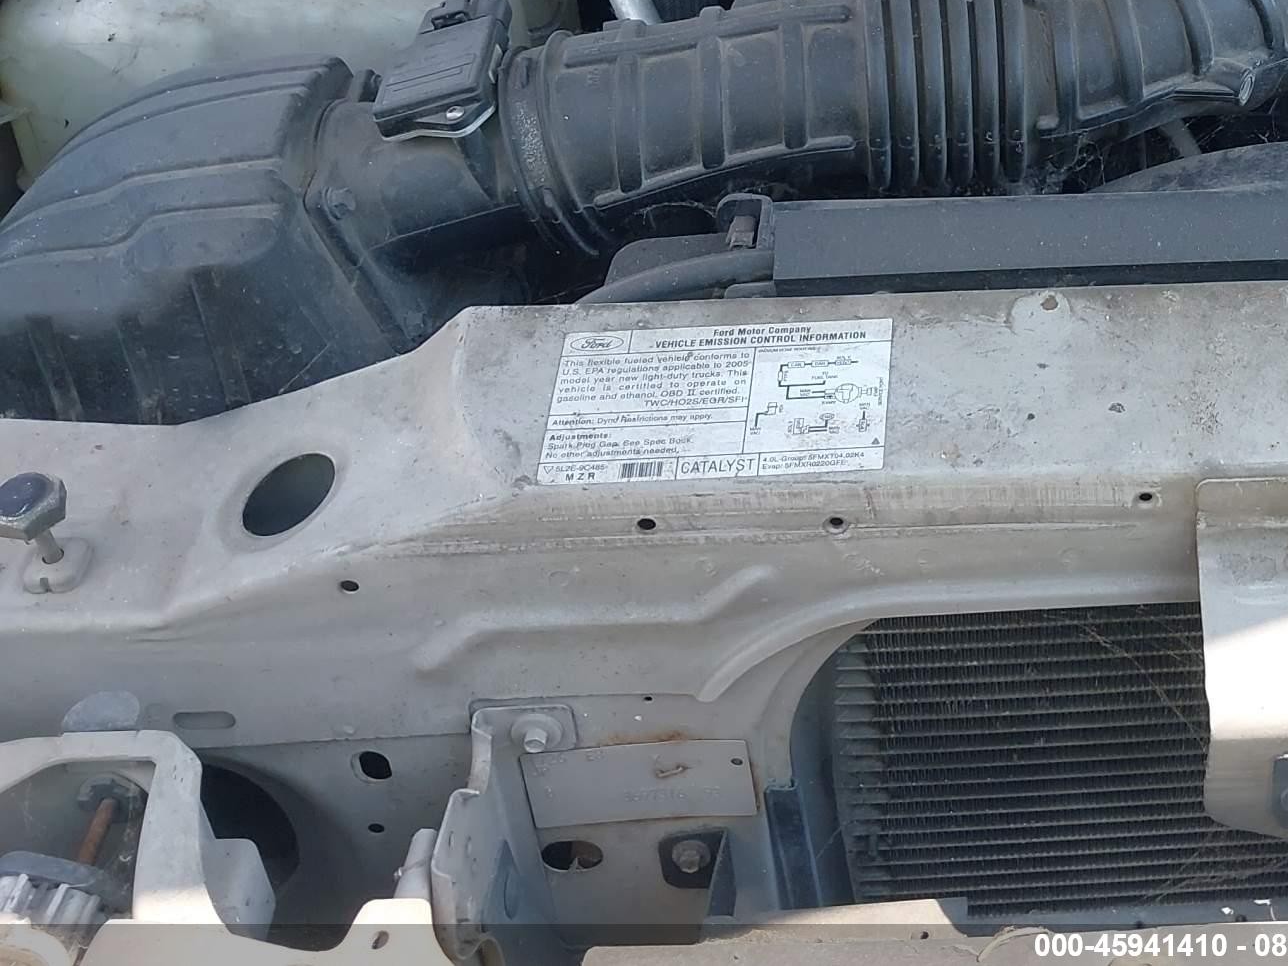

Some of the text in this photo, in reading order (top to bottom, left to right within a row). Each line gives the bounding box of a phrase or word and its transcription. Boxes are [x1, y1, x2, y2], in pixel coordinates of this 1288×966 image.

[713, 325, 812, 337] Ford Motor Company
[580, 338, 615, 349] Ford
[655, 331, 866, 349] VEHICLE EMISSION CONTROL INFORMATION
[564, 359, 583, 367] This
[587, 358, 620, 366] flexible
[624, 356, 654, 365] fueled
[693, 352, 737, 361] conforms
[607, 365, 659, 375] regulations
[662, 363, 710, 373] applicable
[726, 361, 749, 369] 2005
[560, 377, 589, 385] model
[594, 375, 615, 385] year
[618, 375, 638, 383] new
[642, 372, 688, 382] light-duty
[727, 369, 748, 377] This
[558, 385, 595, 394] vehicle
[618, 381, 662, 391] certified
[686, 378, 727, 388] operate
[556, 393, 597, 404] gasoline
[600, 392, 617, 400] and
[660, 389, 683, 397] OBD
[552, 416, 595, 426] Attention:
[670, 414, 687, 422] may
[689, 413, 713, 421] apply.
[549, 432, 612, 442] Adjustments:
[547, 442, 573, 451] Spark
[576, 441, 596, 450] Plug
[643, 438, 666, 447] Spec
[545, 451, 557, 459] No
[560, 450, 586, 458] other
[587, 448, 640, 458] adjustments
[681, 458, 756, 474] CATALYST
[565, 472, 595, 481] M Z R
